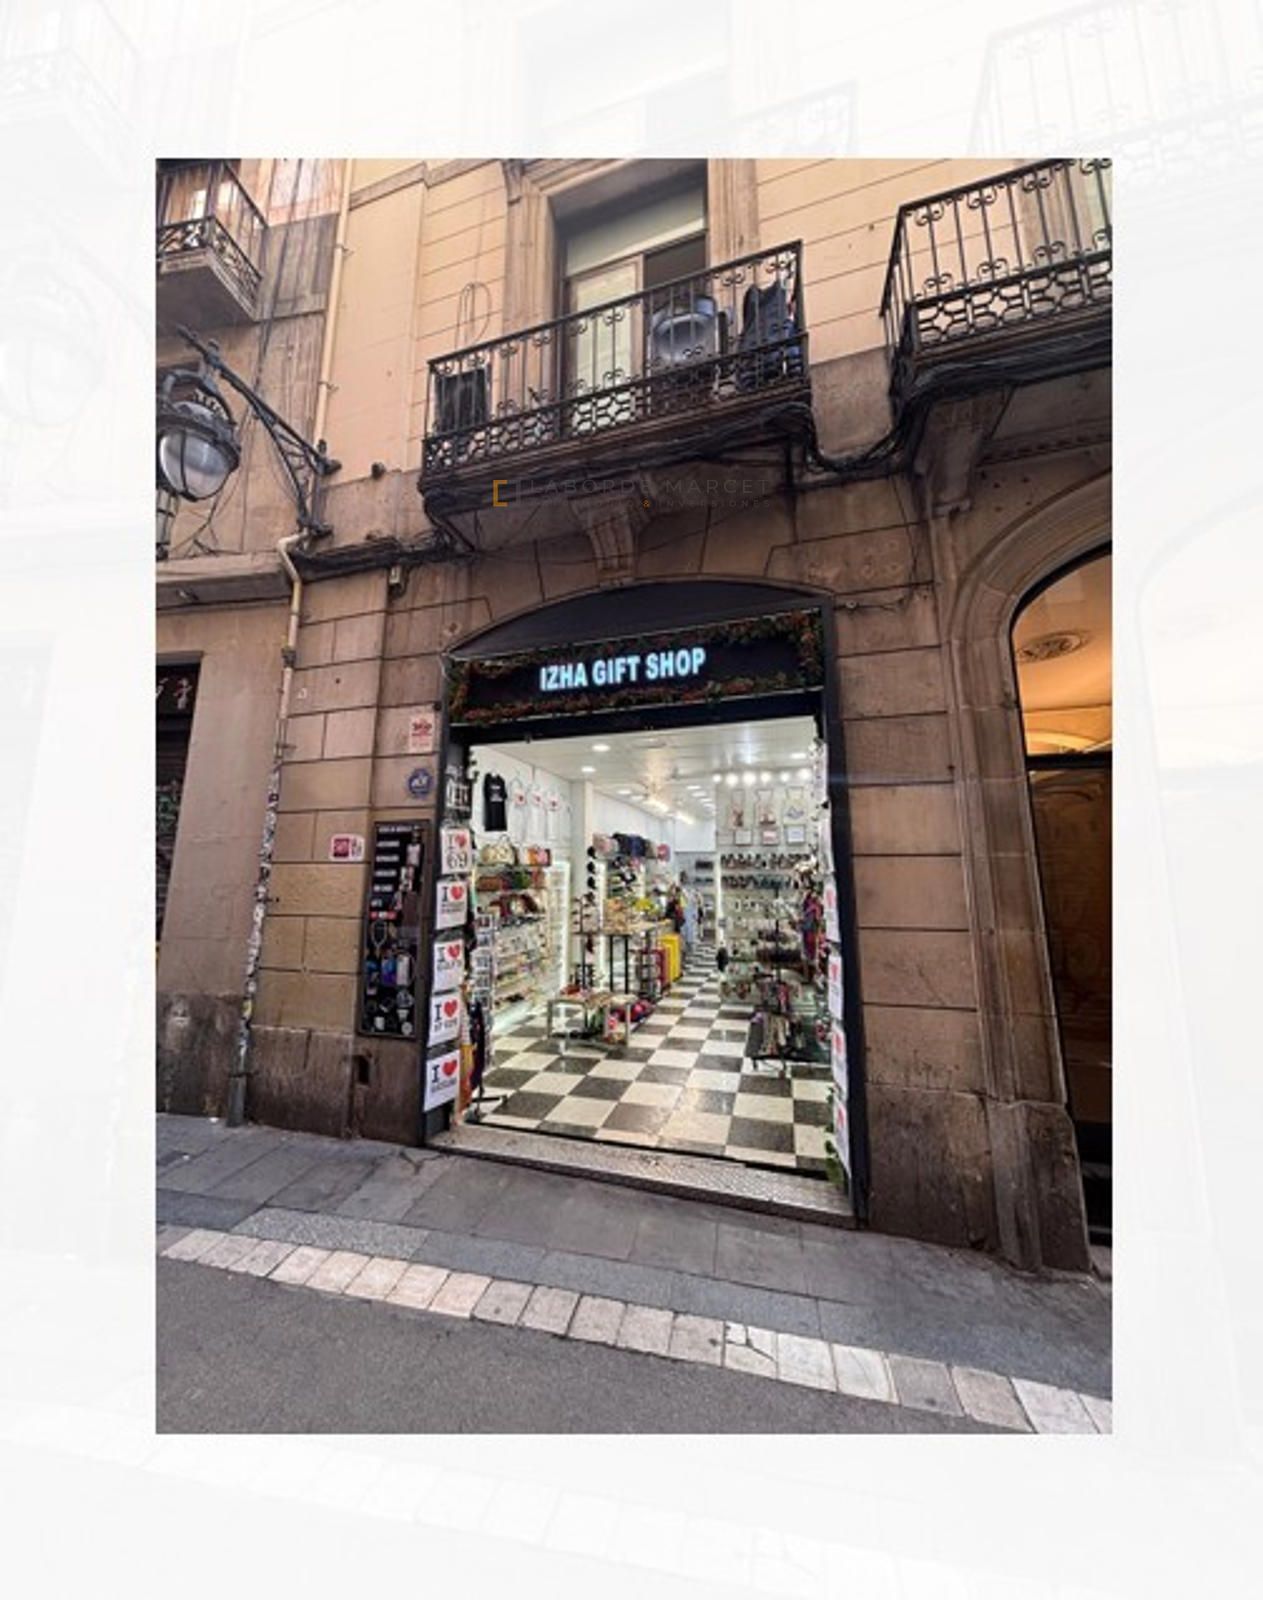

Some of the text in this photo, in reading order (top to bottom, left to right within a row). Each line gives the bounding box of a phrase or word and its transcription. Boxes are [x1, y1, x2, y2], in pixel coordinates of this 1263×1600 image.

[540, 647, 706, 691] IZHA GIFT SHOP
